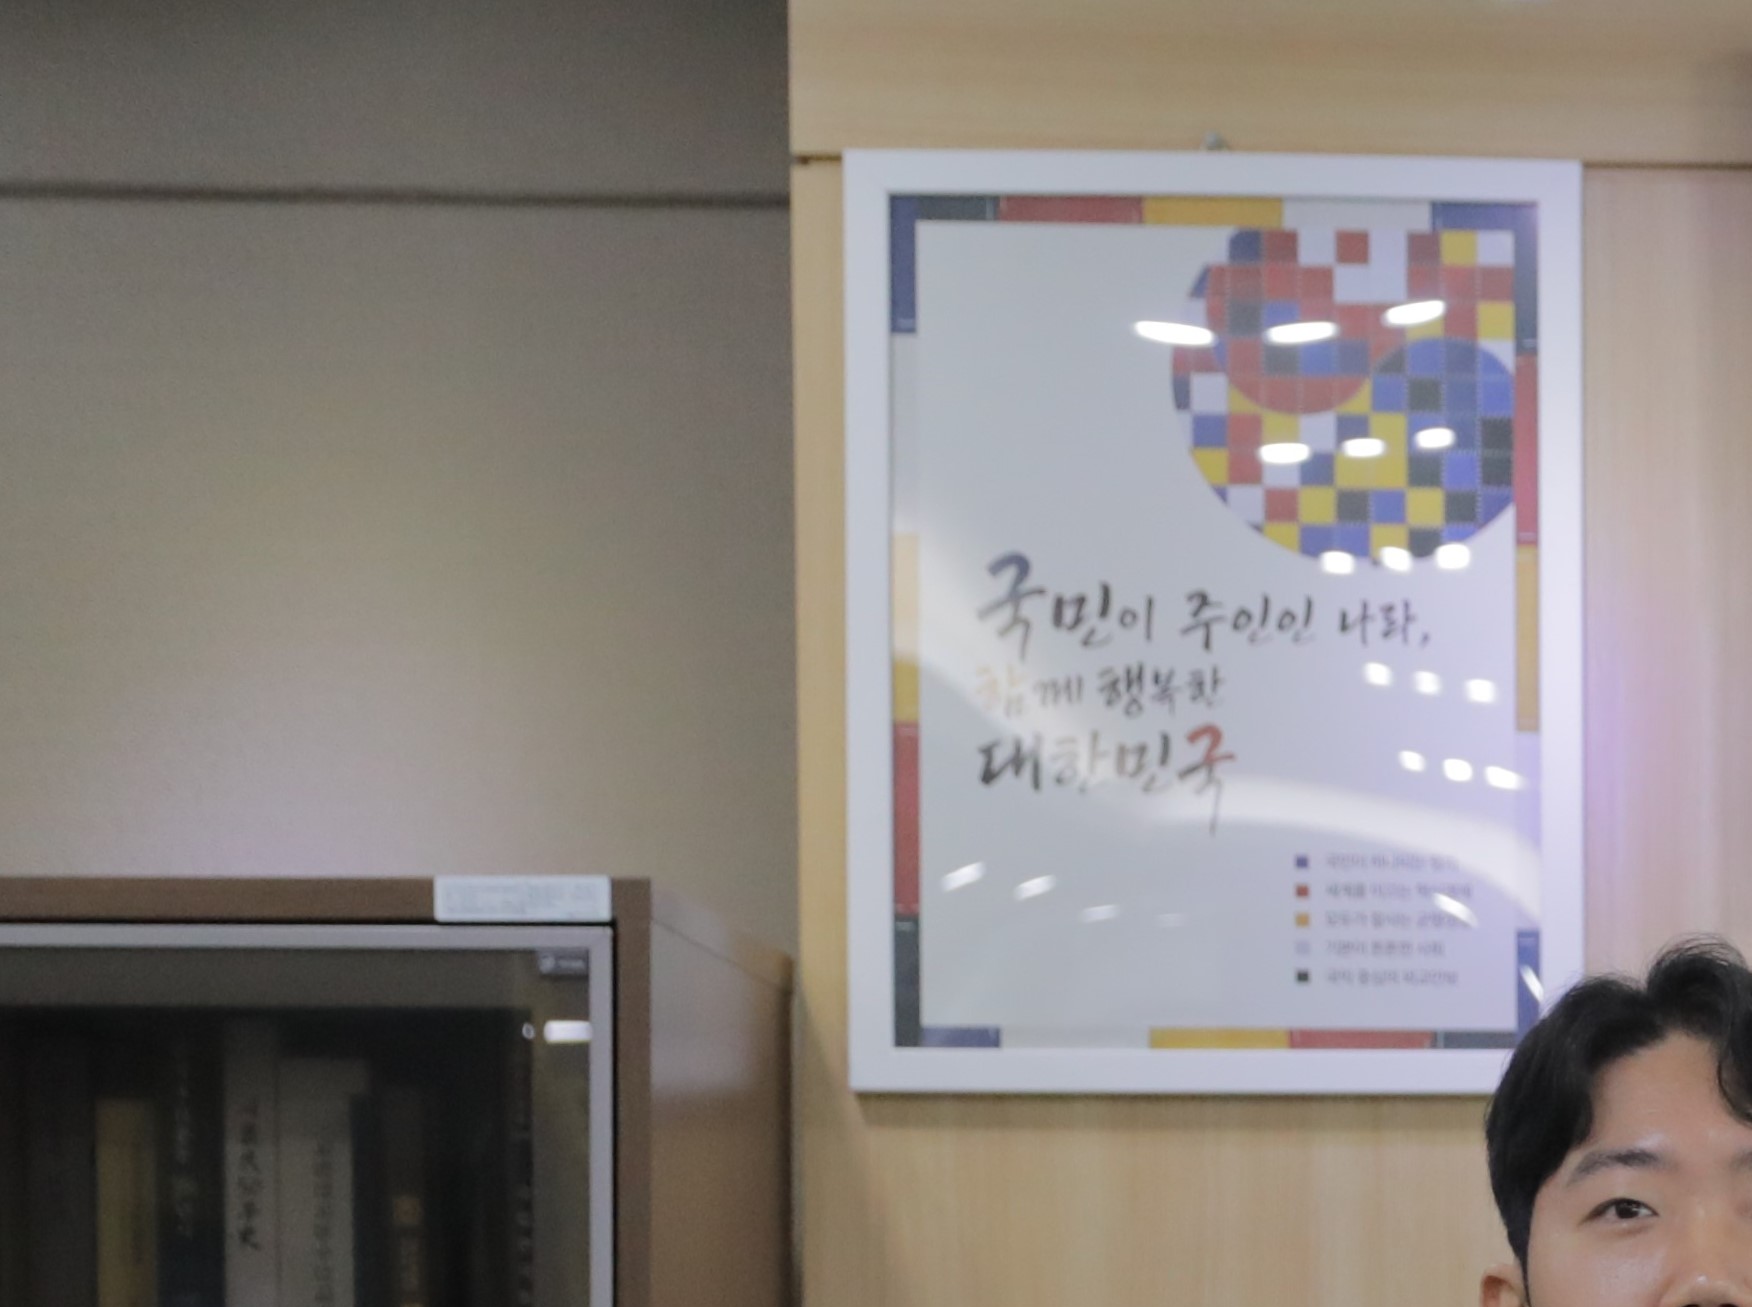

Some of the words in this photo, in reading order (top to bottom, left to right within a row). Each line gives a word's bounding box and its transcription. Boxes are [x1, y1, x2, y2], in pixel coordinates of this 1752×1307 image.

[977, 552, 1154, 660] 국민이
[1180, 589, 1314, 651] 주인인
[1338, 597, 1431, 648] 나라,
[1096, 660, 1225, 718] 행복한
[978, 724, 1236, 836] 대한민국
